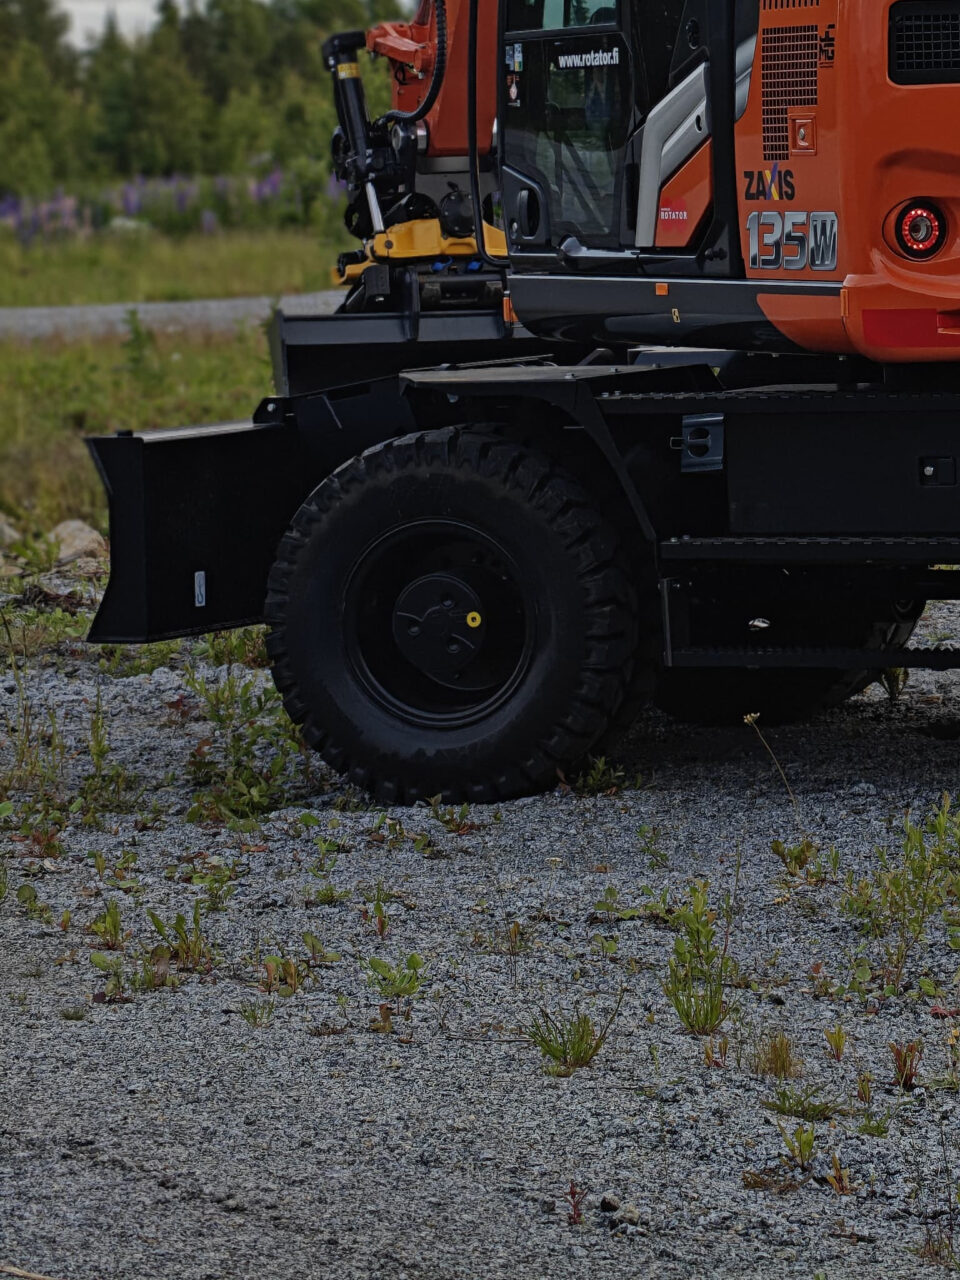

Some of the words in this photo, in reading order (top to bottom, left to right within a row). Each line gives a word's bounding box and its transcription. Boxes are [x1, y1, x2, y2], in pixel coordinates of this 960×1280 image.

[558, 47, 619, 68] www.rotator.fi
[743, 161, 796, 201] ZAXIS
[660, 211, 688, 220] ROTATOR
[746, 211, 838, 271] 135W
